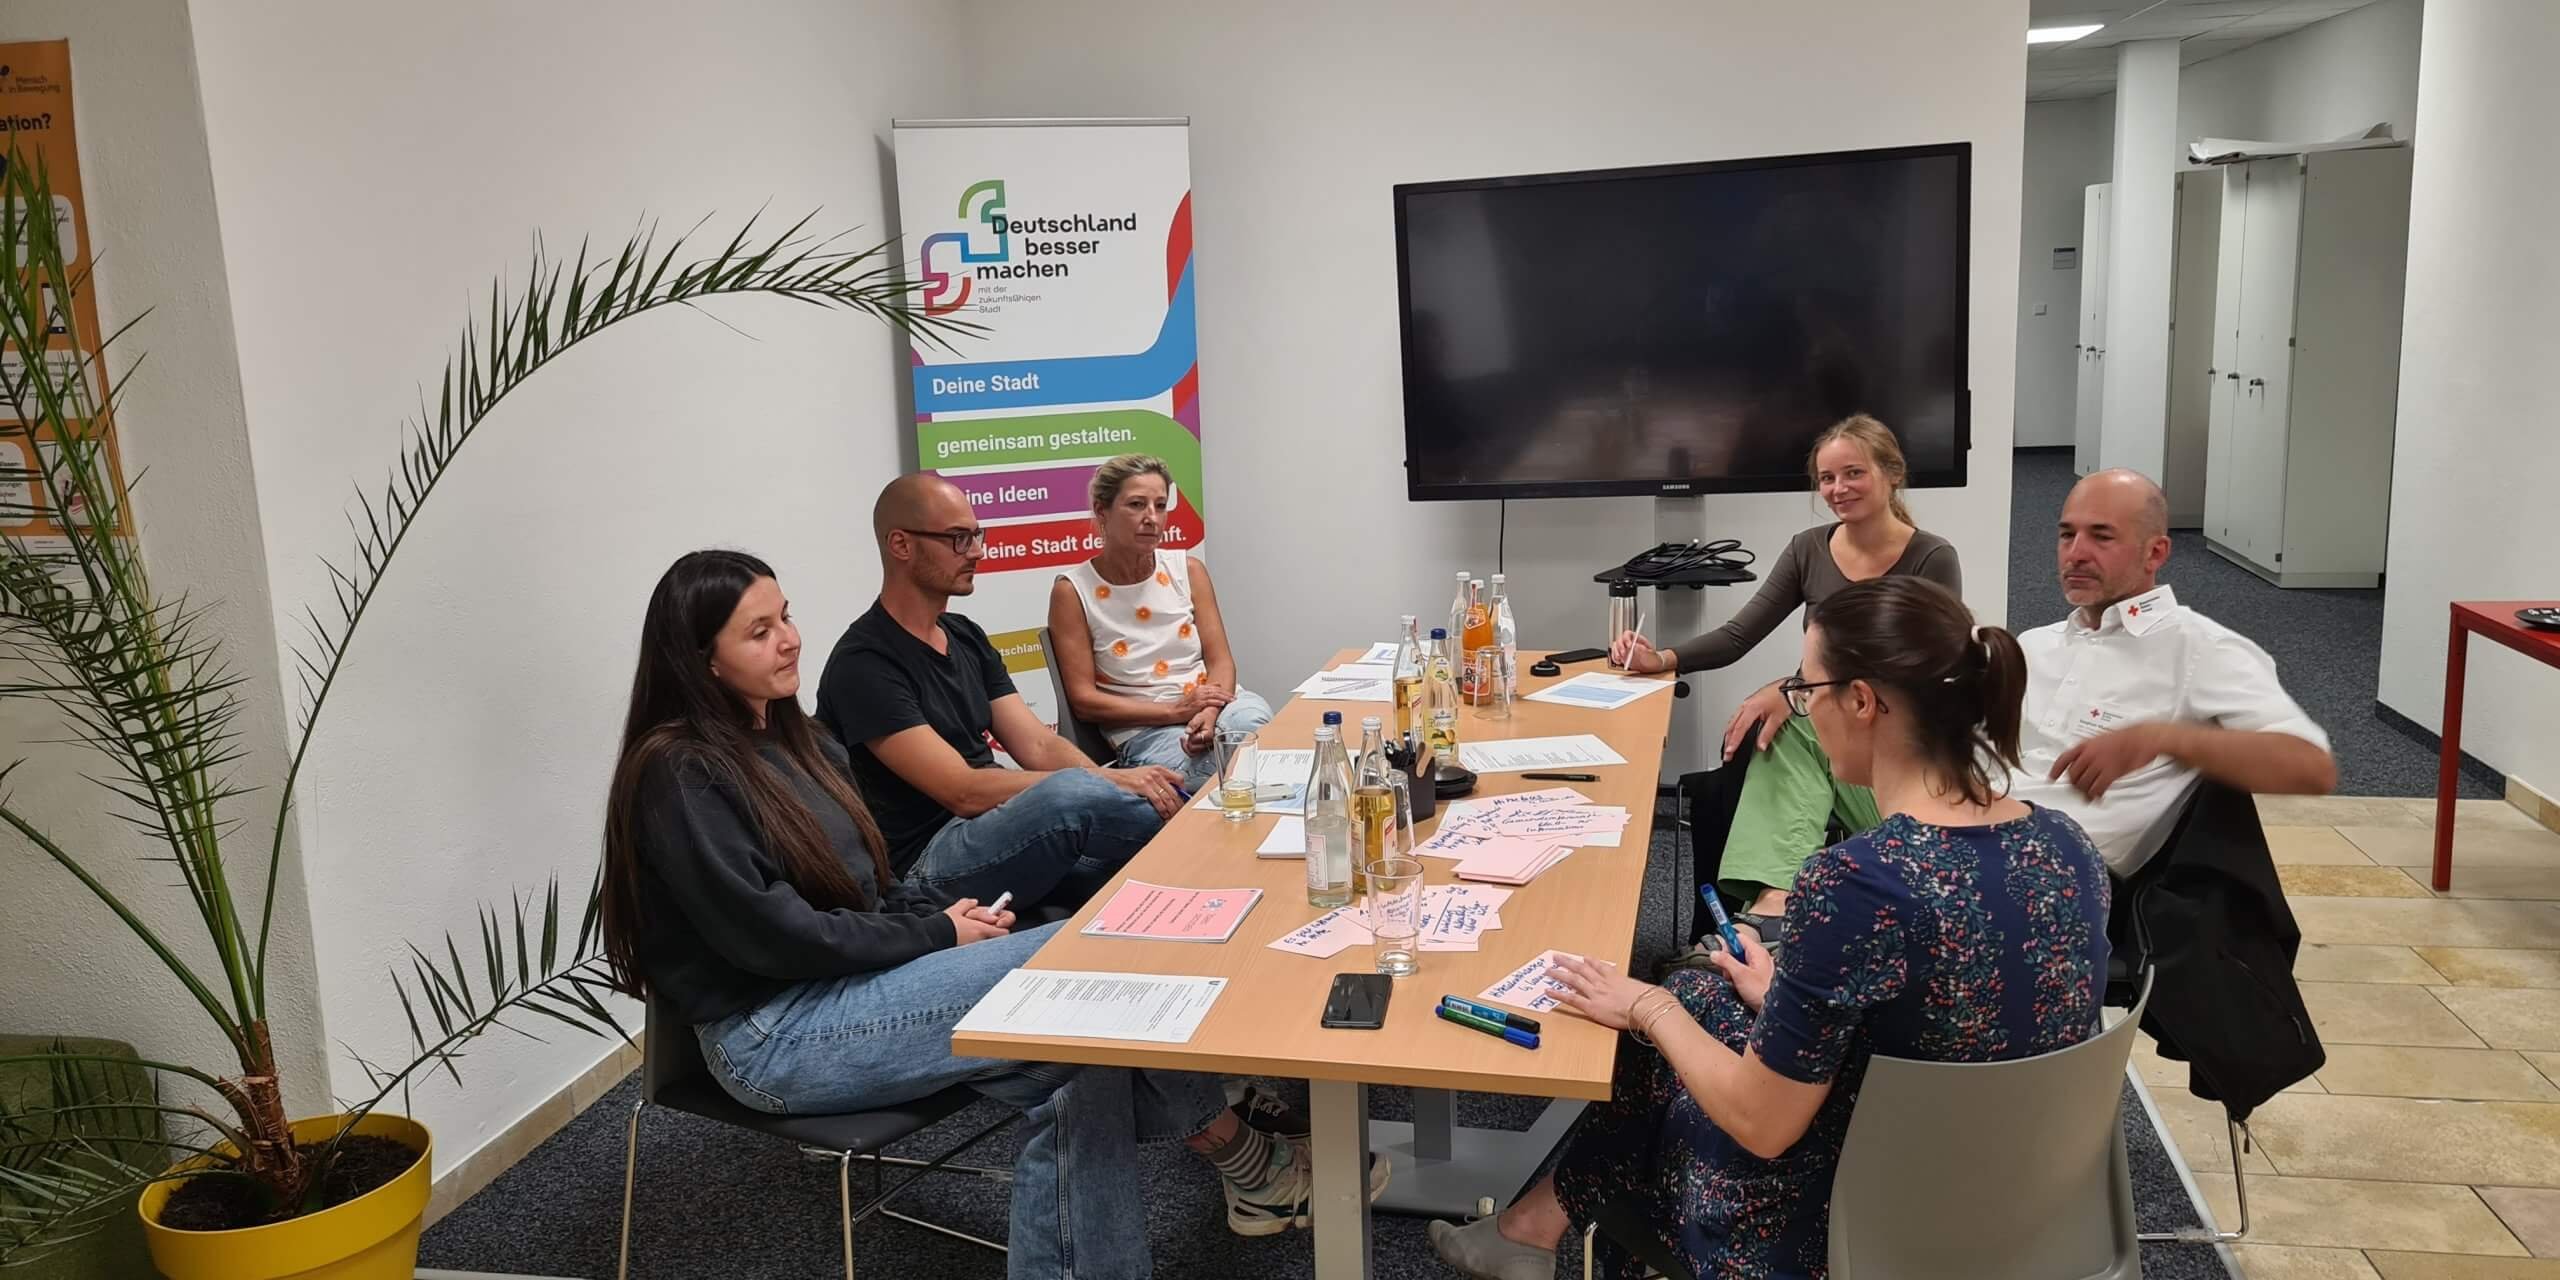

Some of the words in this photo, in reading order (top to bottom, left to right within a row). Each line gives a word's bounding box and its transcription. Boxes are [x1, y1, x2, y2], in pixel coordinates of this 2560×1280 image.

[992, 212, 1137, 235] Deutschland
[1025, 238, 1100, 256] besser
[976, 260, 1069, 280] machen
[977, 286, 992, 294] mit
[993, 285, 1008, 293] der
[932, 377, 986, 396] Deine
[991, 373, 1040, 392] Stadt
[936, 433, 1044, 458] gemeinsam
[1049, 426, 1137, 450] gestalten.
[966, 489, 994, 506] ine
[998, 485, 1048, 504] Ideen
[1031, 535, 1079, 555] Stadt
[1082, 533, 1105, 550] de
[1159, 525, 1187, 544] nft.
[1000, 643, 1043, 657] tschlan
